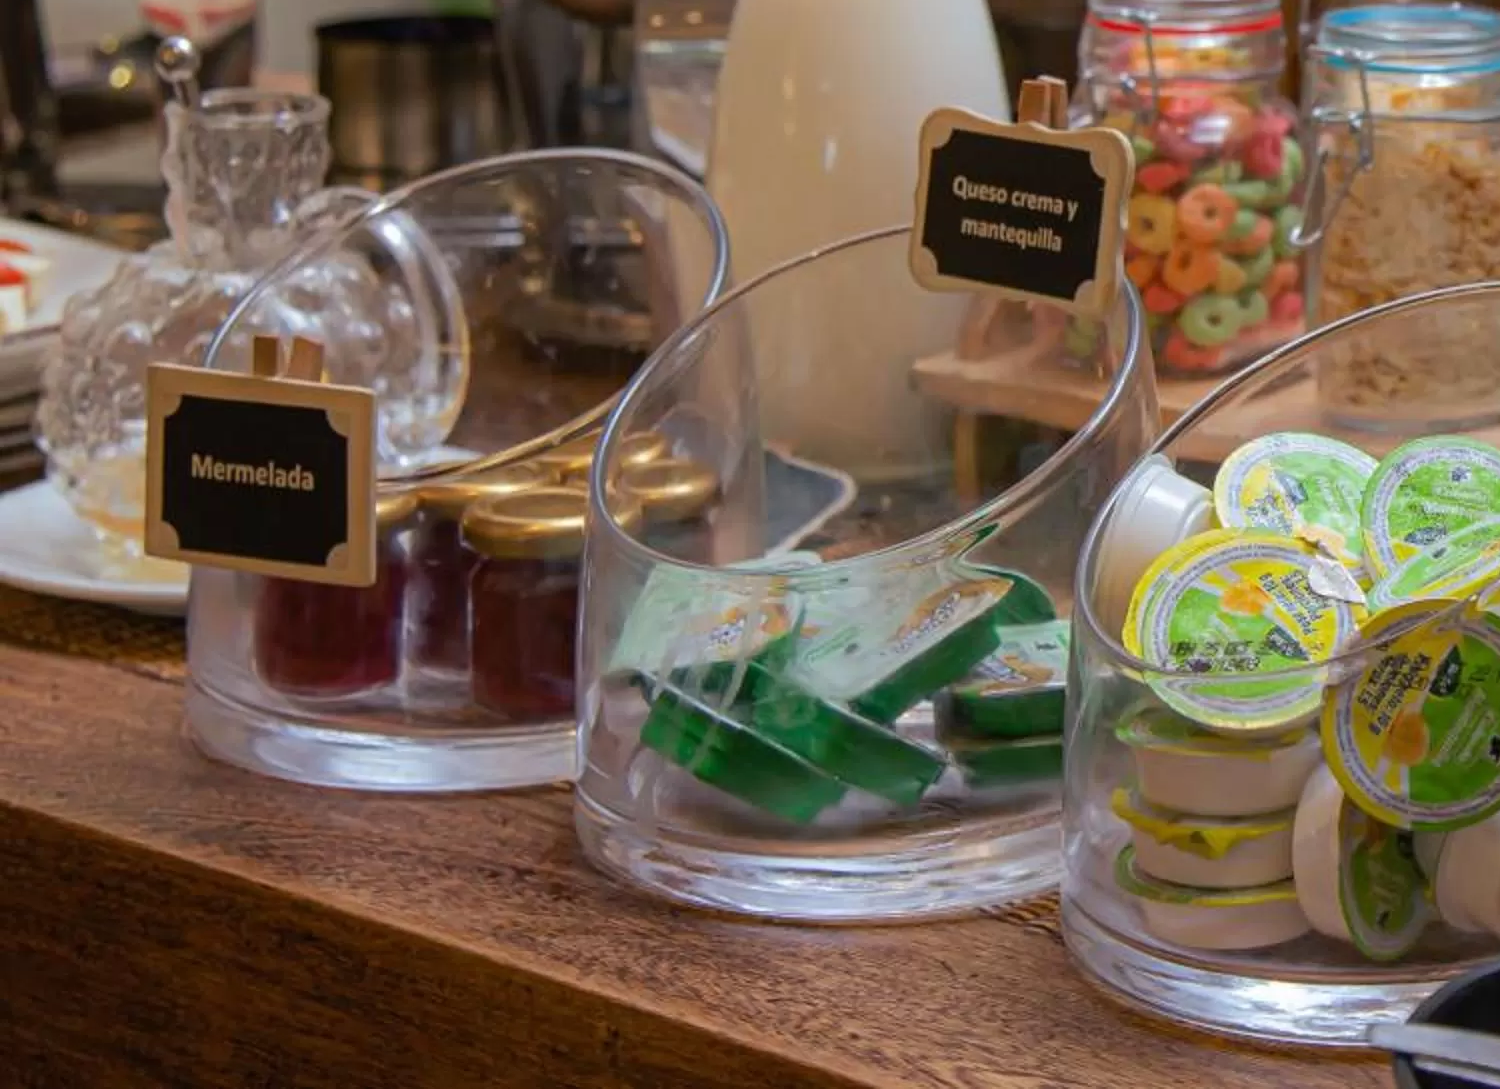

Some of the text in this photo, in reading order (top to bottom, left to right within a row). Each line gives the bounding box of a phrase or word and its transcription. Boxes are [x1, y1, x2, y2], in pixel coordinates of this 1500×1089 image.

[953, 176, 1079, 222] Queso crema y
[960, 218, 1063, 252] mantequilla
[190, 452, 315, 492] Mermelada
